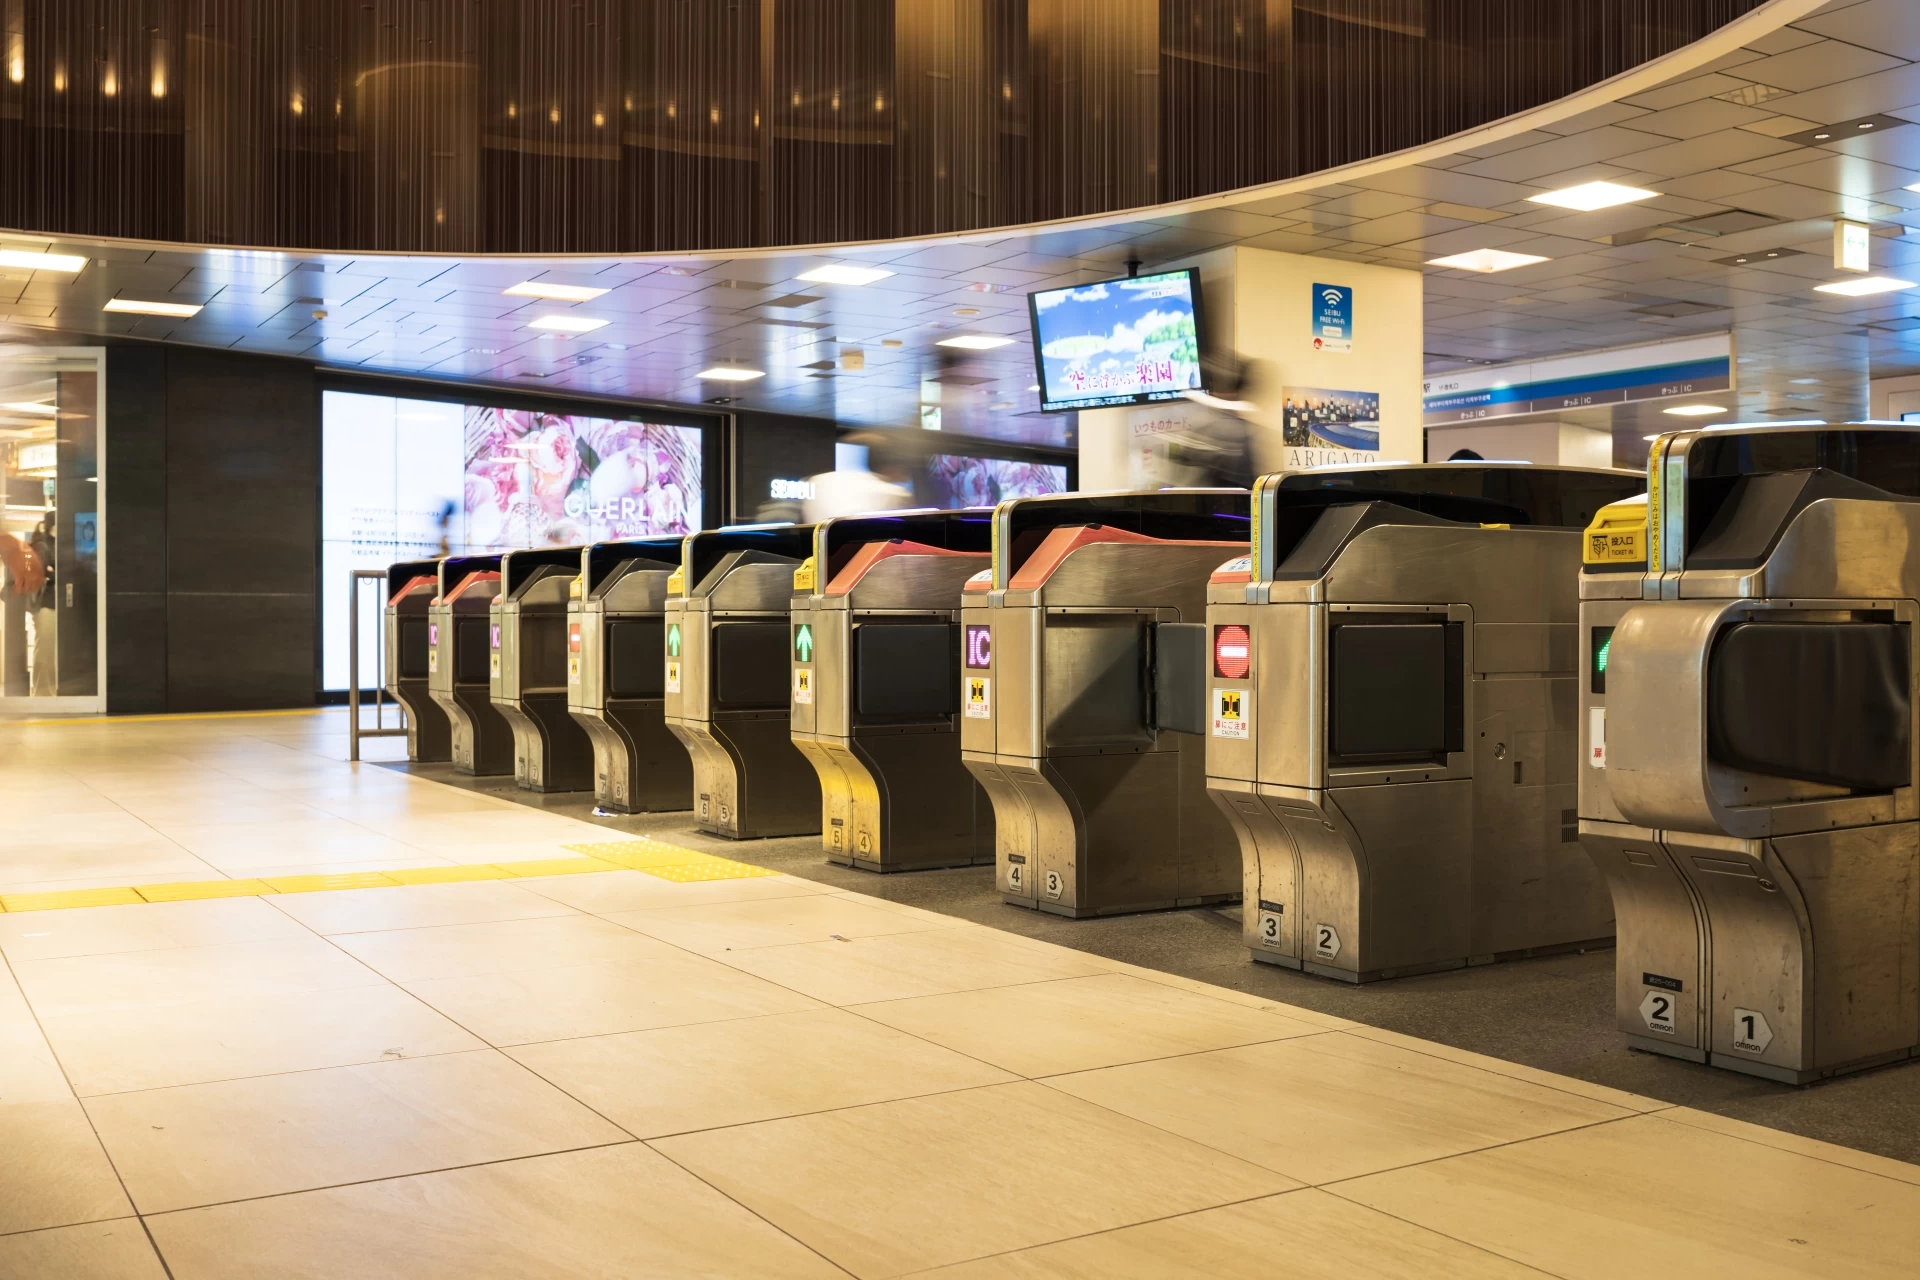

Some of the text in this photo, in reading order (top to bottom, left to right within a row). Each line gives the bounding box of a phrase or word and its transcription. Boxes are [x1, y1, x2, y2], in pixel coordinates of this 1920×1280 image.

[1319, 315, 1332, 324] FREE
[1324, 308, 1342, 317] SEIBU
[1661, 384, 1692, 395] きっぷ IC
[1563, 396, 1591, 407] きっぷ IC
[1460, 409, 1486, 420] きっぷ IC
[1289, 449, 1375, 466] ARIGATO
[563, 493, 689, 522] GUERLAIN
[616, 522, 645, 534] PARIS
[1611, 536, 1634, 546] 投入口
[1611, 548, 1627, 556] TICKET
[968, 630, 990, 665] IC
[702, 802, 707, 815] 6
[722, 806, 727, 820] 5
[834, 830, 840, 844] 5
[860, 835, 867, 850] 4
[1011, 867, 1020, 883] 4
[1048, 874, 1057, 891] 3
[1265, 917, 1277, 937] 3
[1319, 928, 1332, 950] 2
[1651, 996, 1669, 1022] 2
[1741, 1015, 1754, 1040] 1
